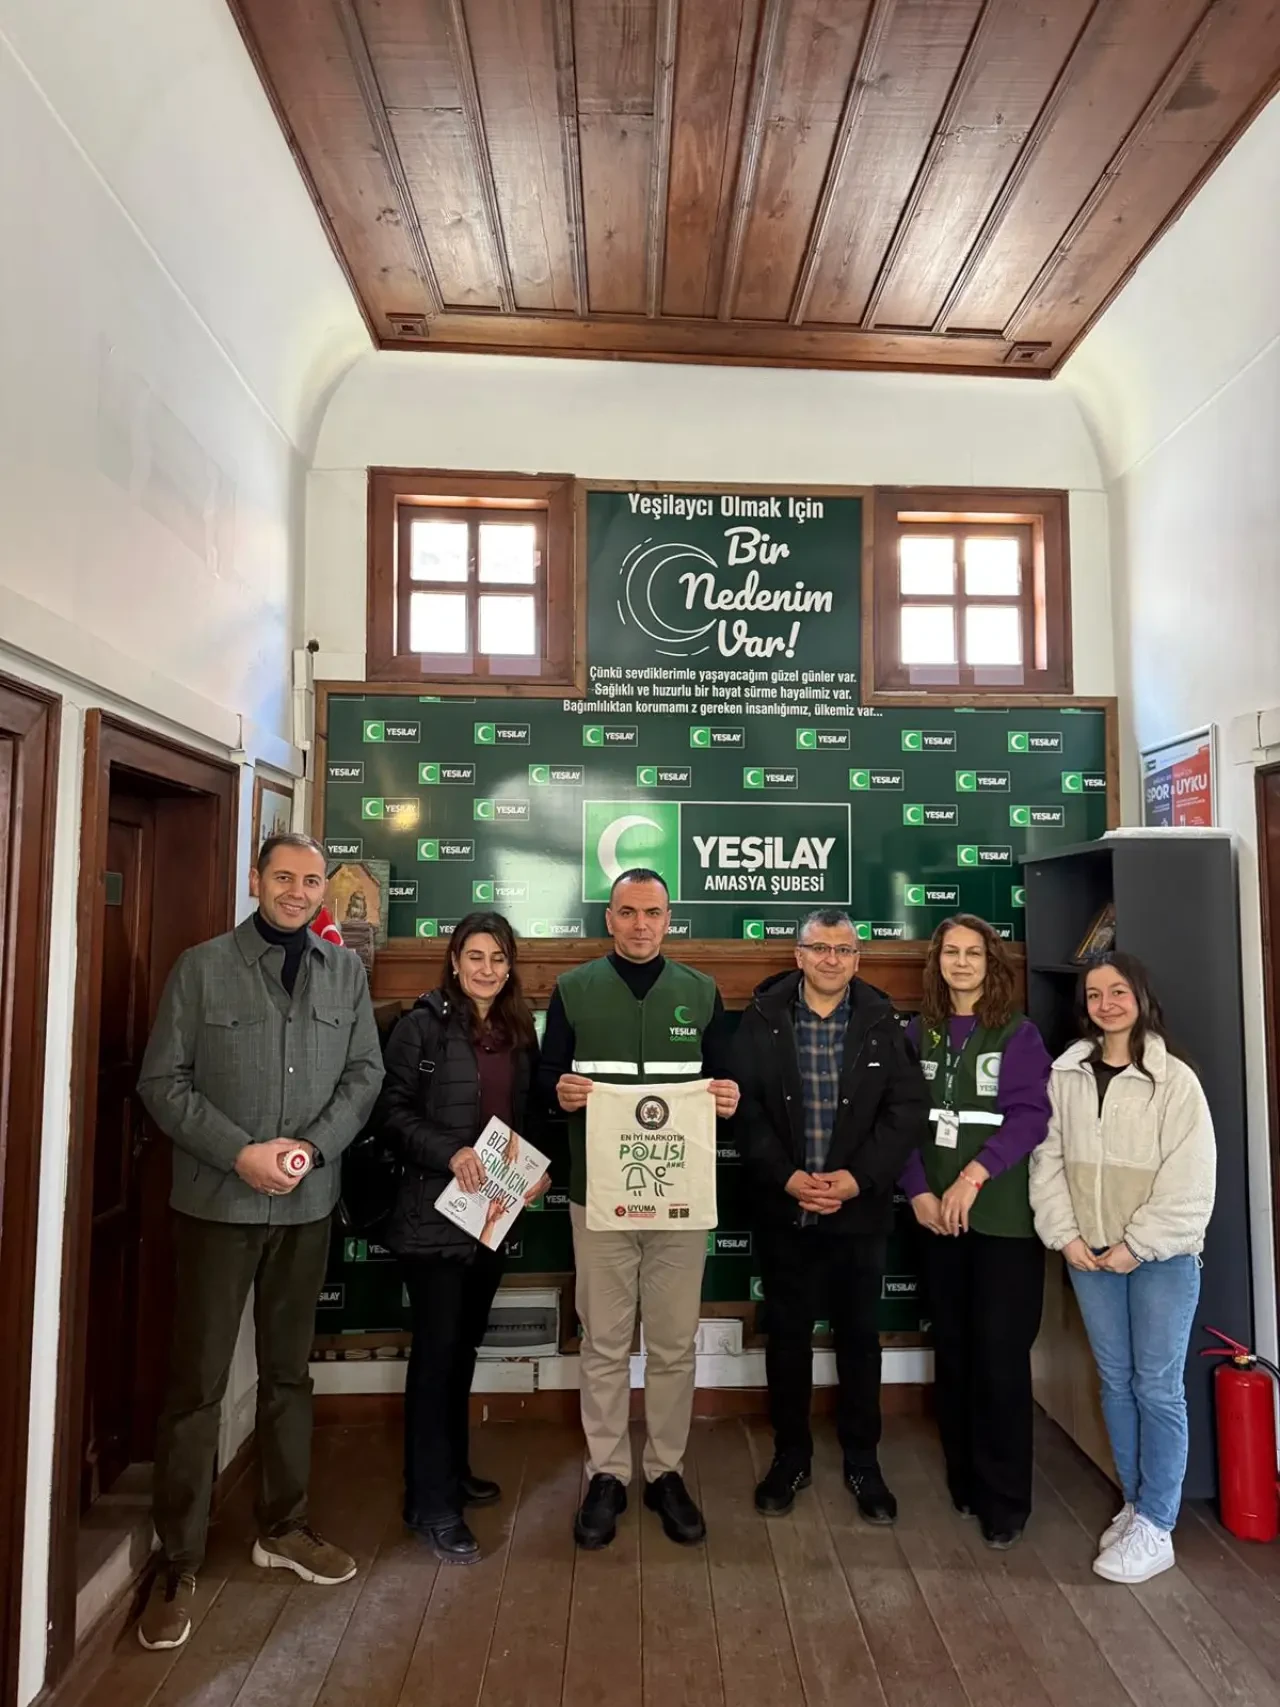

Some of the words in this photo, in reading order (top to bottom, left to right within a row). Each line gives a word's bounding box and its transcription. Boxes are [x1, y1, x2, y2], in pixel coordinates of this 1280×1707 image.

[628, 493, 714, 520] Yeşilaycı
[721, 496, 782, 518] Olmak
[724, 526, 790, 566] Bir
[679, 570, 833, 613] Nedenim
[718, 620, 801, 658] Var!
[590, 666, 622, 681] Çünkü
[626, 668, 696, 680] sevdiklerimle
[700, 668, 768, 684] yaşayacağım
[771, 670, 798, 684] güzel
[802, 670, 834, 684] günler
[838, 672, 856, 682] var.
[594, 683, 634, 698] Sağlıklı
[637, 686, 650, 696] ve
[652, 684, 691, 697] huzurlu
[694, 685, 708, 697] bir
[712, 686, 741, 699] hayat
[744, 686, 778, 698] sürme
[780, 686, 830, 700] hayalimiz
[833, 689, 852, 700] var.
[563, 700, 632, 714] Bağımlılıktan
[700, 703, 742, 716] gereken
[746, 702, 812, 718] insanlığımız,
[814, 703, 854, 716] ülkemiz
[858, 706, 883, 717] var...
[1176, 773, 1208, 795] UYKU
[704, 875, 766, 891] AMASYA
[770, 873, 824, 894] ŞUBESİ
[487, 1130, 509, 1154] BİZ
[620, 1134, 632, 1142] EN
[633, 1132, 644, 1142] İYİ
[645, 1134, 684, 1142] NARKOTİK
[620, 1142, 686, 1162] POLİSİ
